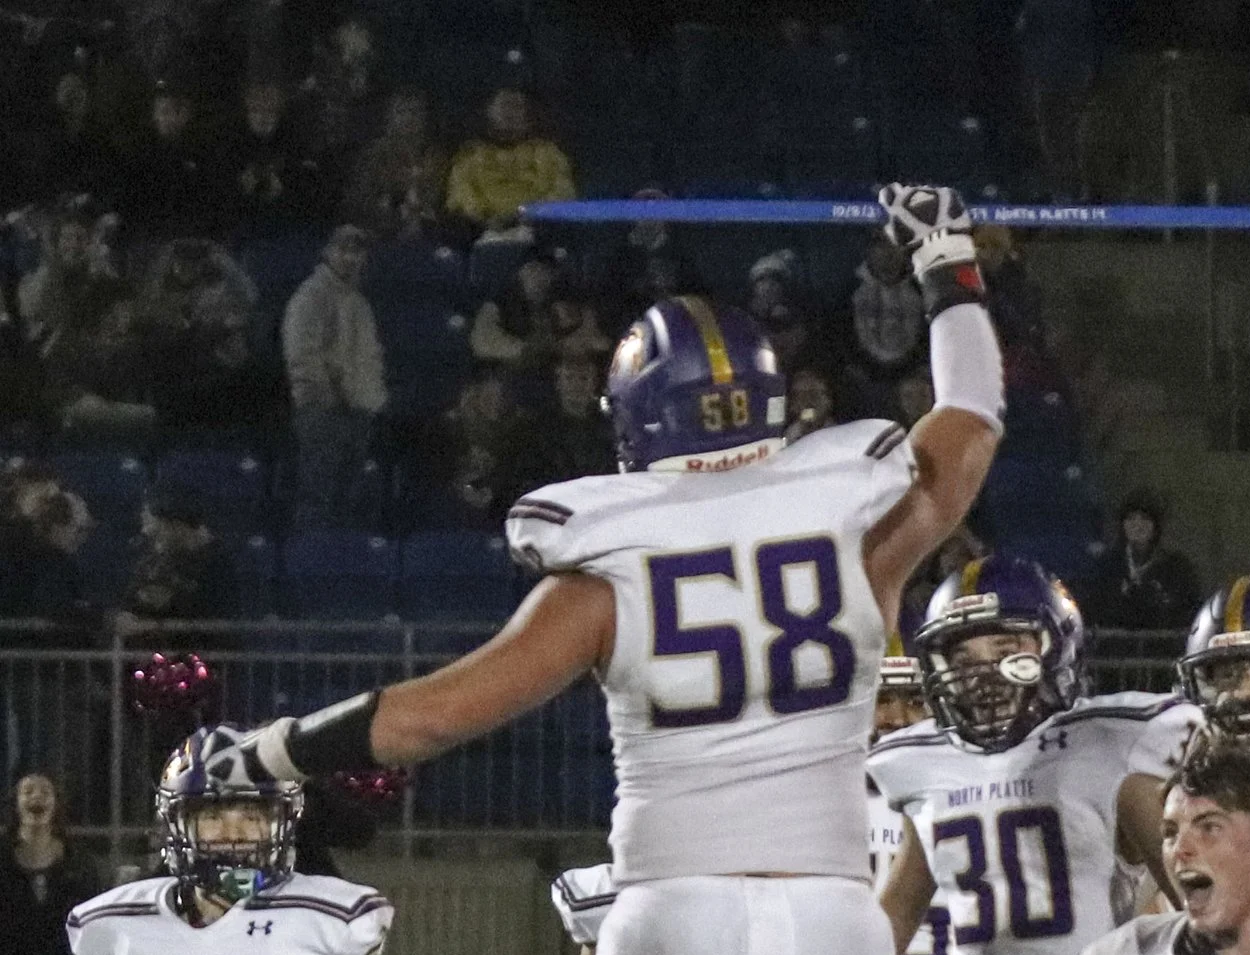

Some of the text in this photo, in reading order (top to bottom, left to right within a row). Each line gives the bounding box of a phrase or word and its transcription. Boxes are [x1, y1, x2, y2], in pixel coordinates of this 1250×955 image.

[700, 389, 749, 433] 58
[686, 444, 769, 472] Riddell
[642, 531, 860, 732] 58
[948, 779, 1035, 807] NORTH PLATTE
[931, 803, 1075, 946] 30
